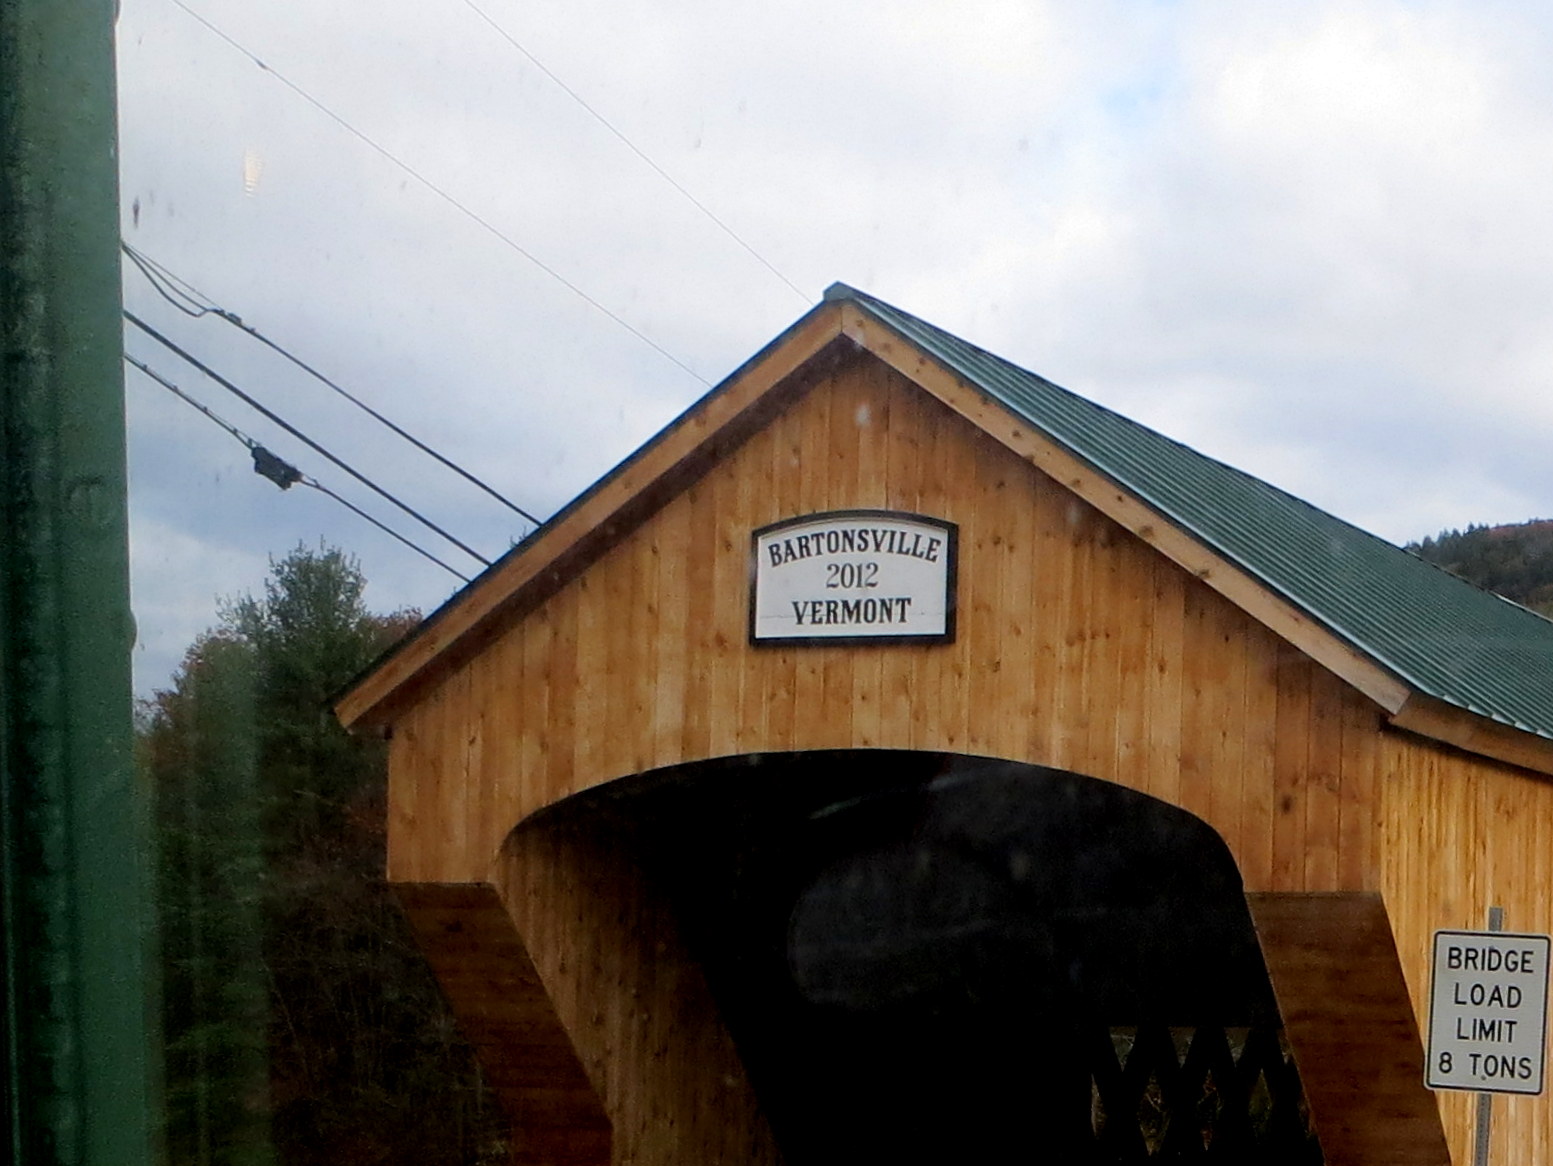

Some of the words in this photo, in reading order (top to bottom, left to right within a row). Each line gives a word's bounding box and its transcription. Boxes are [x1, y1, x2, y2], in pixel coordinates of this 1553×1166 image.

[768, 529, 941, 567] BARTONSVILLE
[826, 562, 879, 588] 2012
[792, 598, 912, 625] VERMONT
[1447, 946, 1534, 974] BRIDGE
[1454, 982, 1522, 1008] LOAD
[1456, 1017, 1518, 1043] LIMIT
[1438, 1051, 1453, 1074] 8
[1468, 1053, 1532, 1080] TONS
